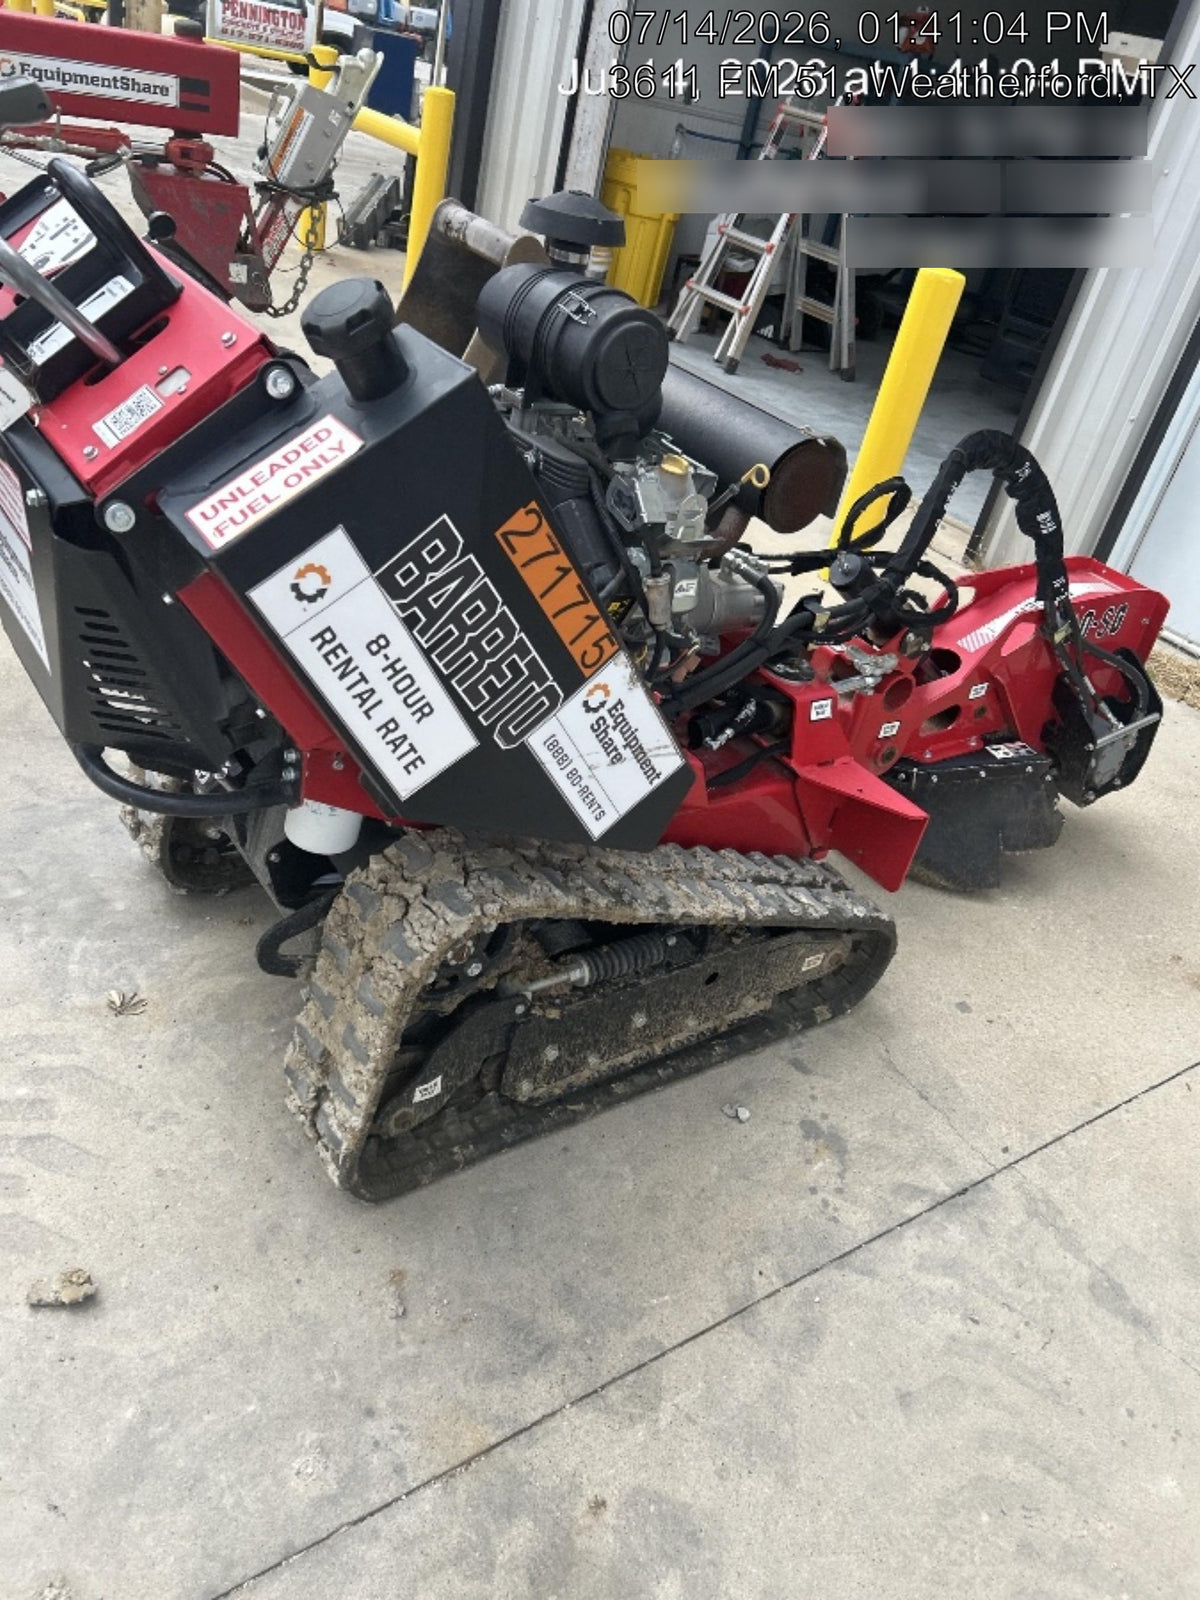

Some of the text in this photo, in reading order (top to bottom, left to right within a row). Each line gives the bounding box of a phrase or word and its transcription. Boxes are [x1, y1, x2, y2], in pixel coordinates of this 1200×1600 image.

[222, 0, 305, 31] PENNINGTON
[19, 61, 170, 97] EquipmentShare
[200, 427, 333, 522] UNLEADED
[213, 440, 346, 538] FUEL ONLY
[372, 513, 565, 749] BARRETO
[499, 507, 617, 670] 271715
[309, 625, 426, 775] RENTAL RATE
[365, 634, 435, 724] 8-HOUR
[543, 733, 574, 771] (888)
[589, 716, 624, 766] Share
[606, 698, 663, 785] Equipment
